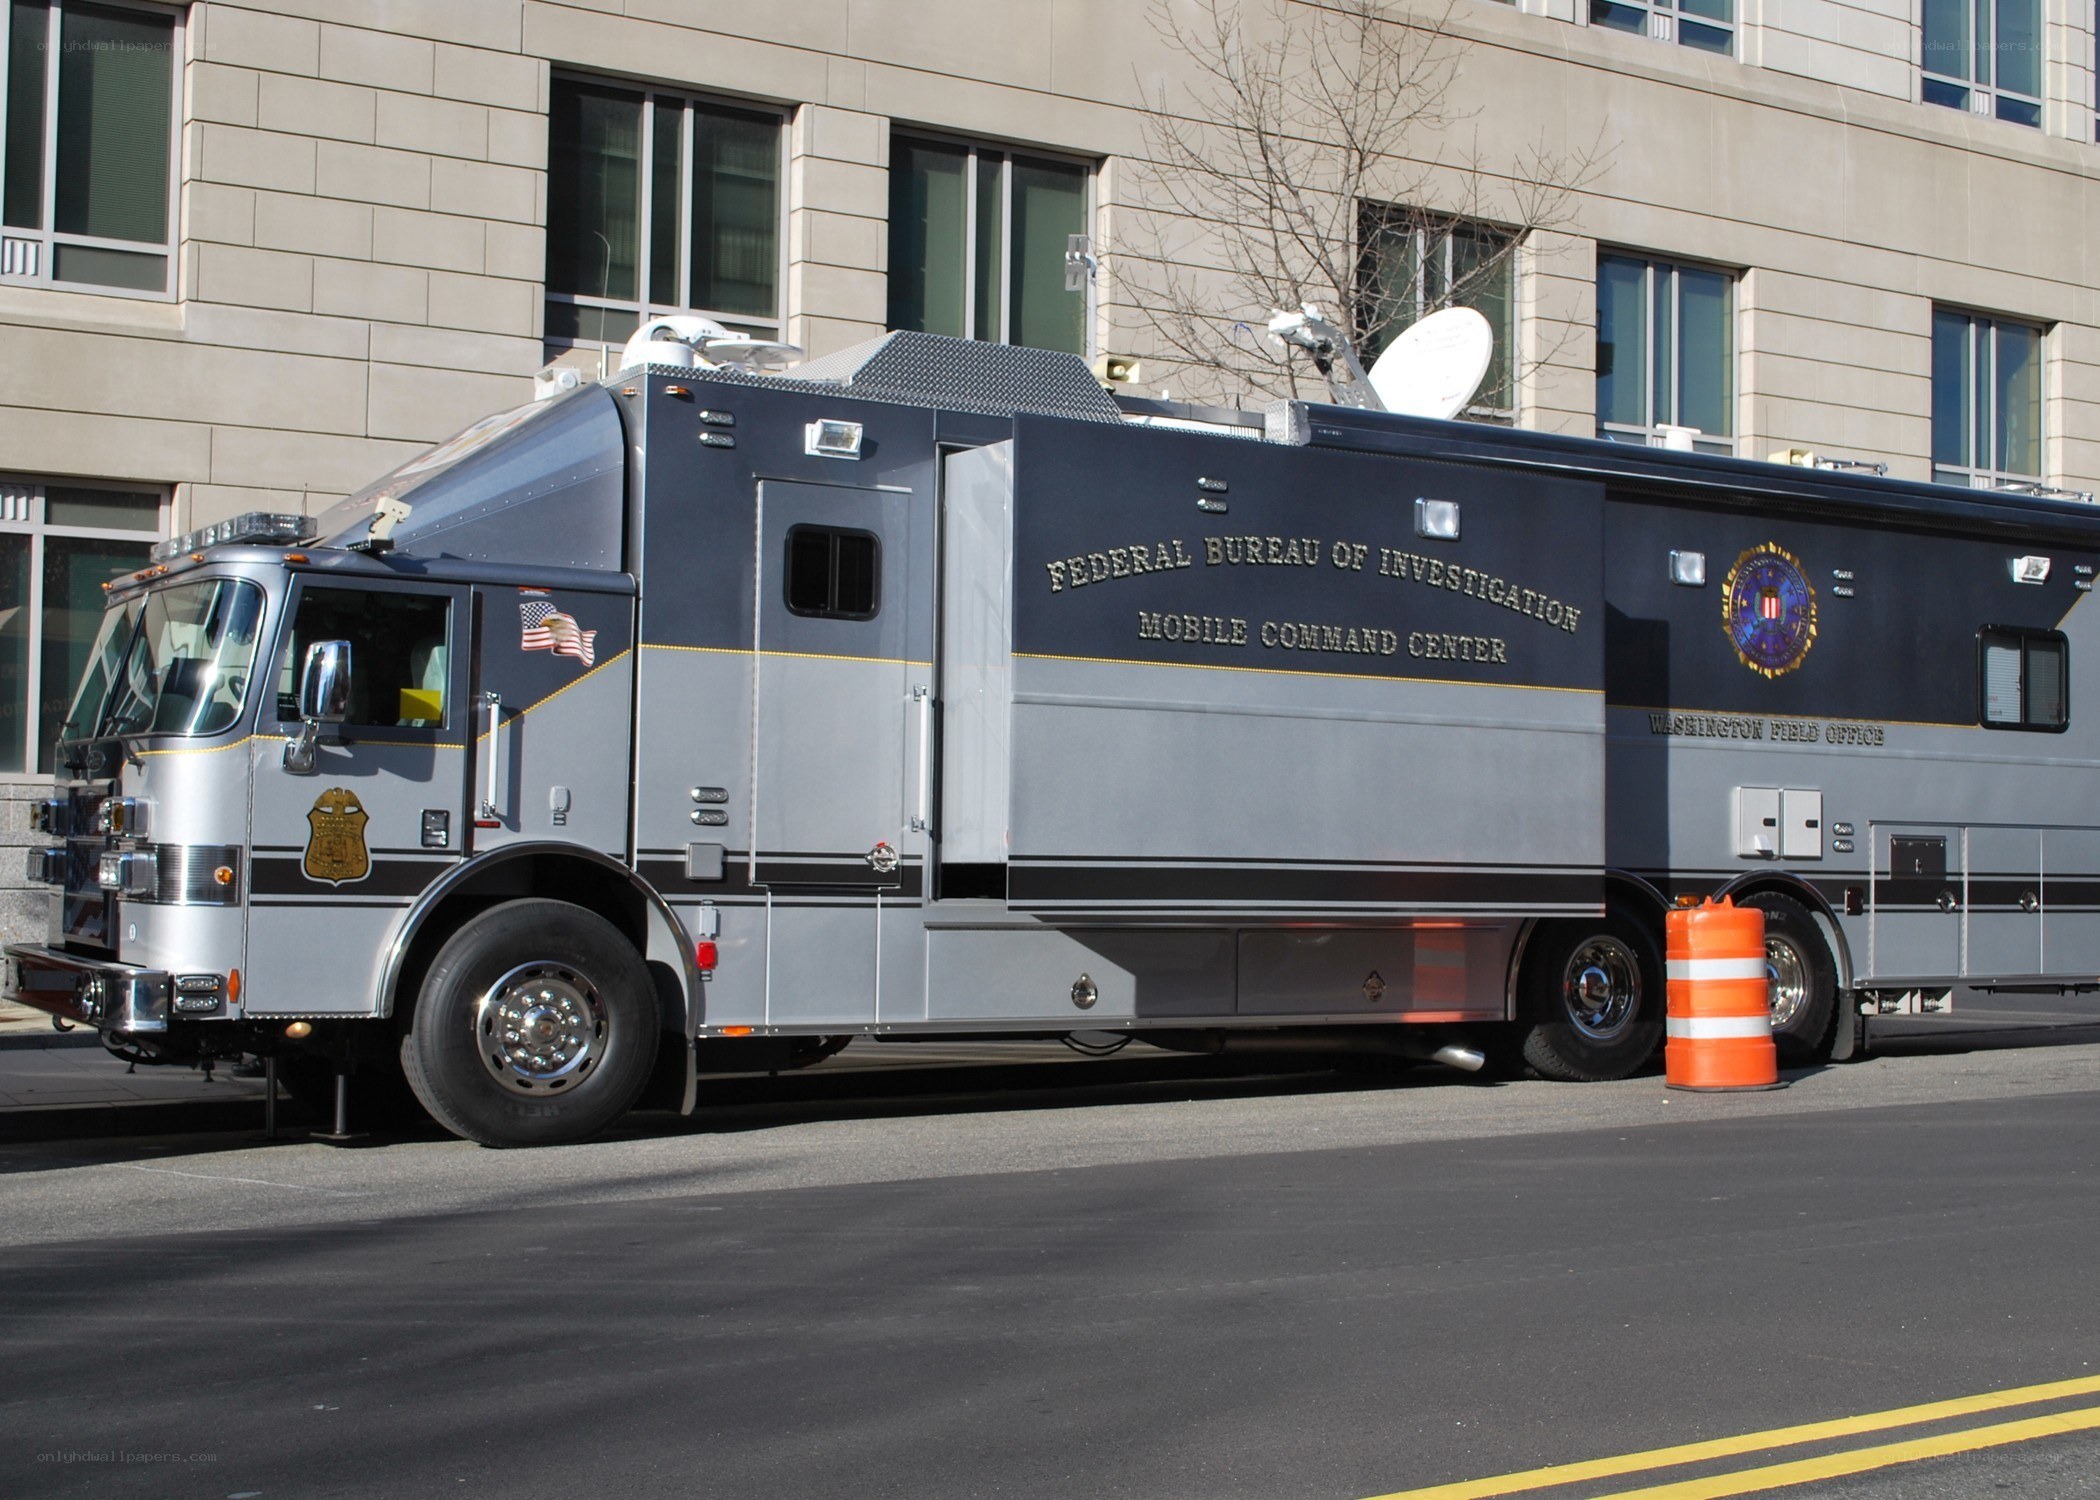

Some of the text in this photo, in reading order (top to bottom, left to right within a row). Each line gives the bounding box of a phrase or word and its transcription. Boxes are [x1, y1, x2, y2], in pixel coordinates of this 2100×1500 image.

[1047, 536, 1581, 634] FEDERAL BUREAU OF INVESTIGATION
[1138, 611, 1508, 664] MOBILE COMMAND CENTER
[1649, 714, 1885, 746] WASHINGTON FIELD OFFICE
